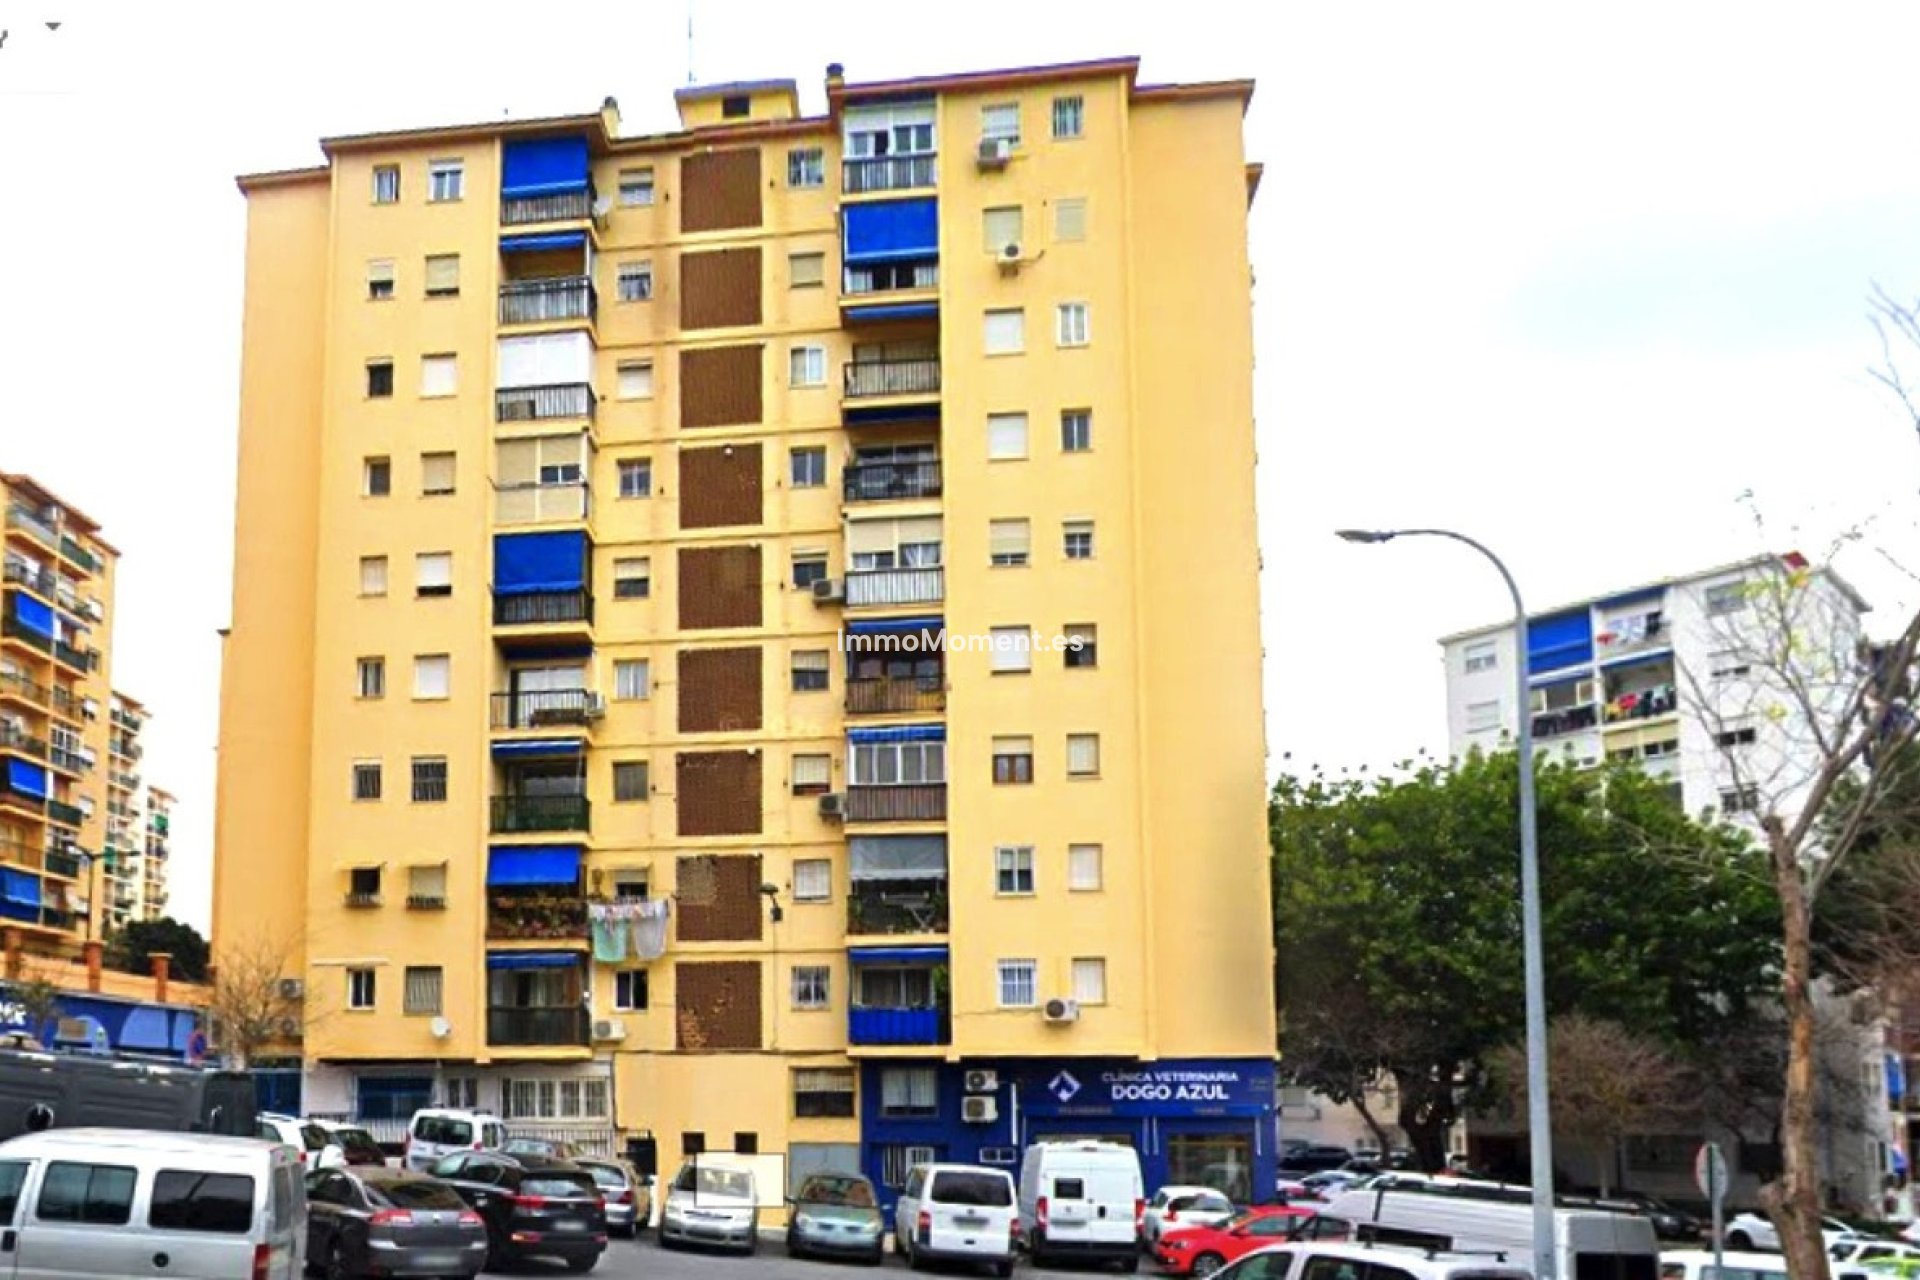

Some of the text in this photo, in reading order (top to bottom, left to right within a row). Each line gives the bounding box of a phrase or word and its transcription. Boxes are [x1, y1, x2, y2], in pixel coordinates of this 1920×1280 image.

[1153, 1071, 1239, 1082] VETERINARIA
[1111, 1084, 1171, 1100] DOGO
[1175, 1084, 1230, 1100] AZUL
